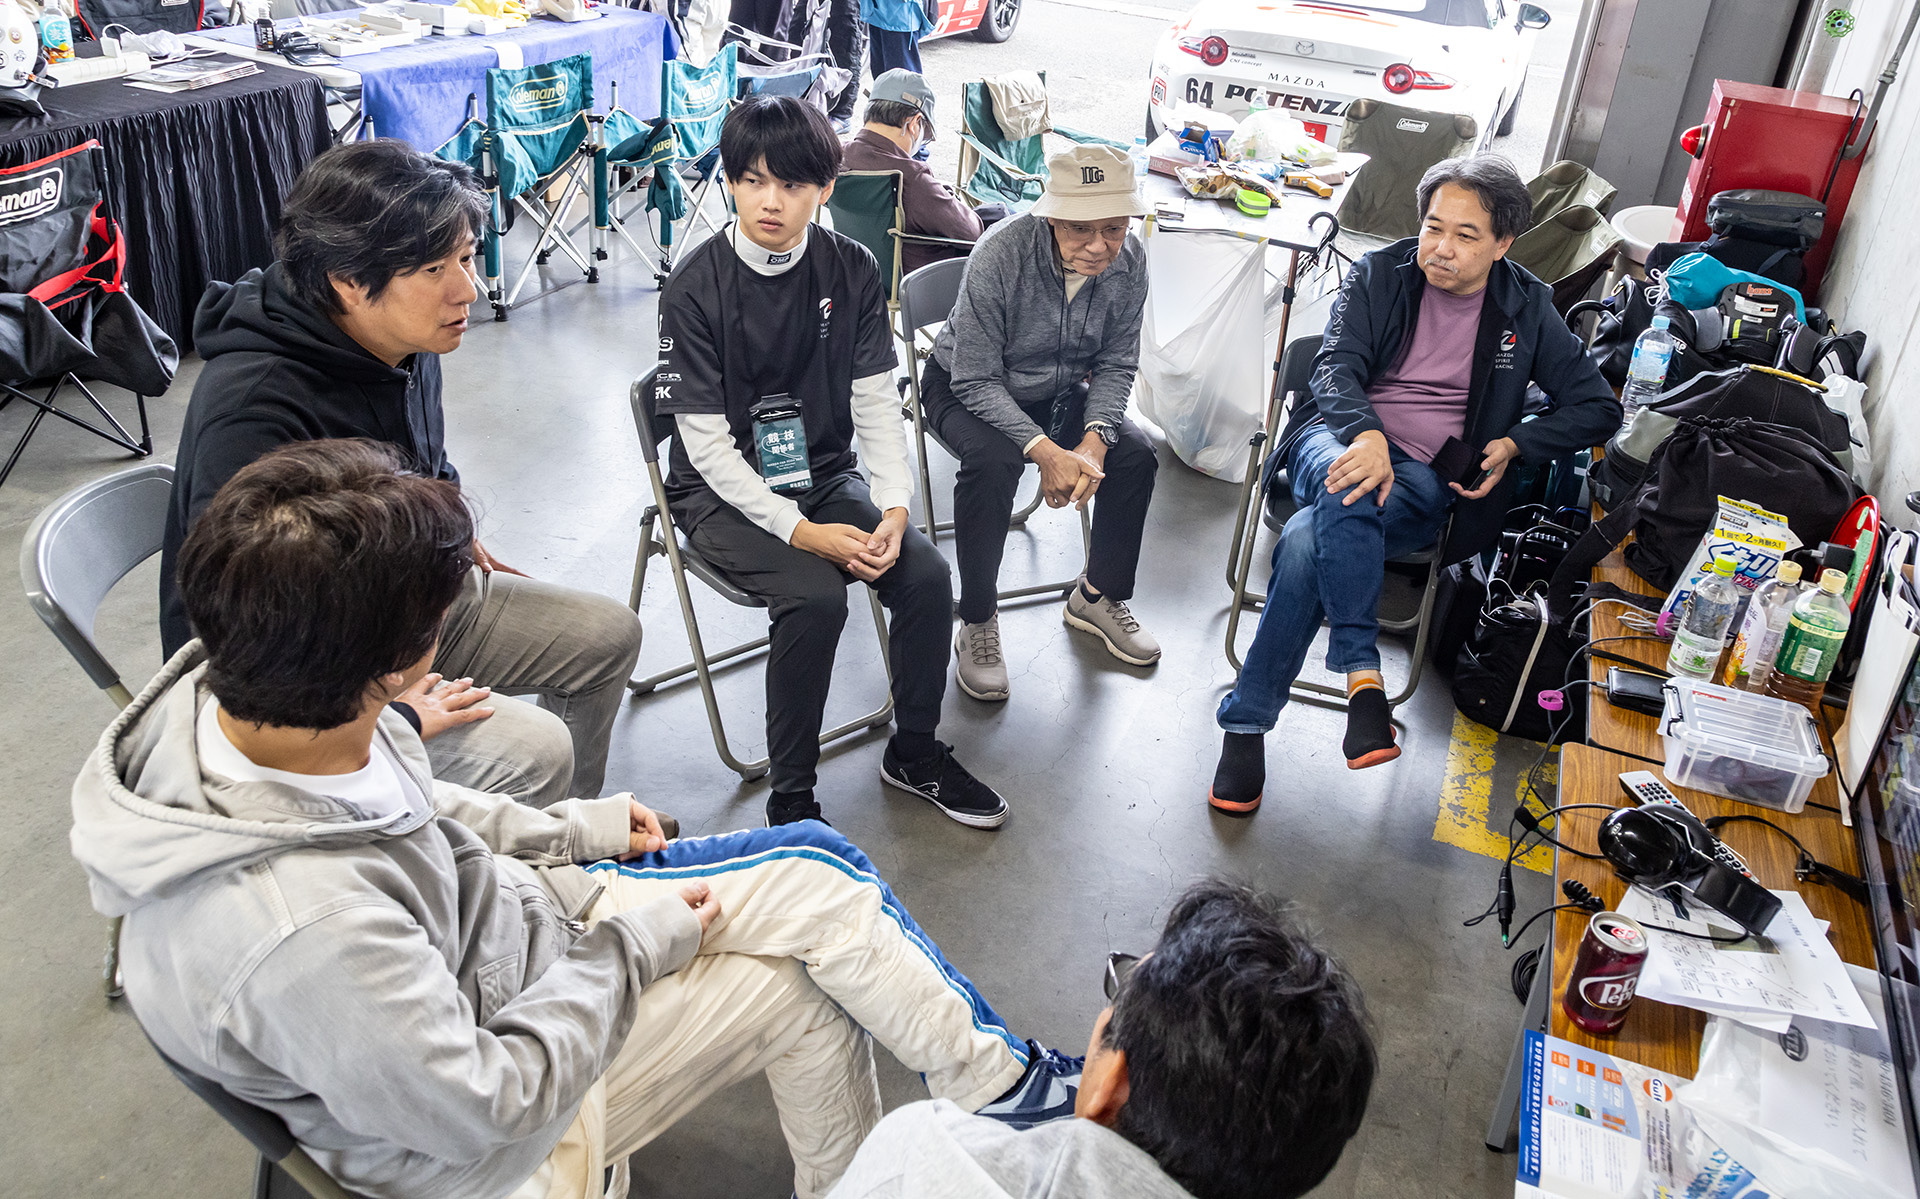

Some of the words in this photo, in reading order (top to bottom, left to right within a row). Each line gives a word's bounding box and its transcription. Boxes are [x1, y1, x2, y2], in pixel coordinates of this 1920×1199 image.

[1268, 72, 1325, 88] MAZDA
[511, 86, 556, 101] Coleman
[1186, 77, 1214, 109] 64
[0, 187, 41, 212] man
[1323, 318, 1344, 352] SPIRI
[1599, 982, 1635, 1006] Pep
[1651, 1078, 1664, 1103] Gulf
